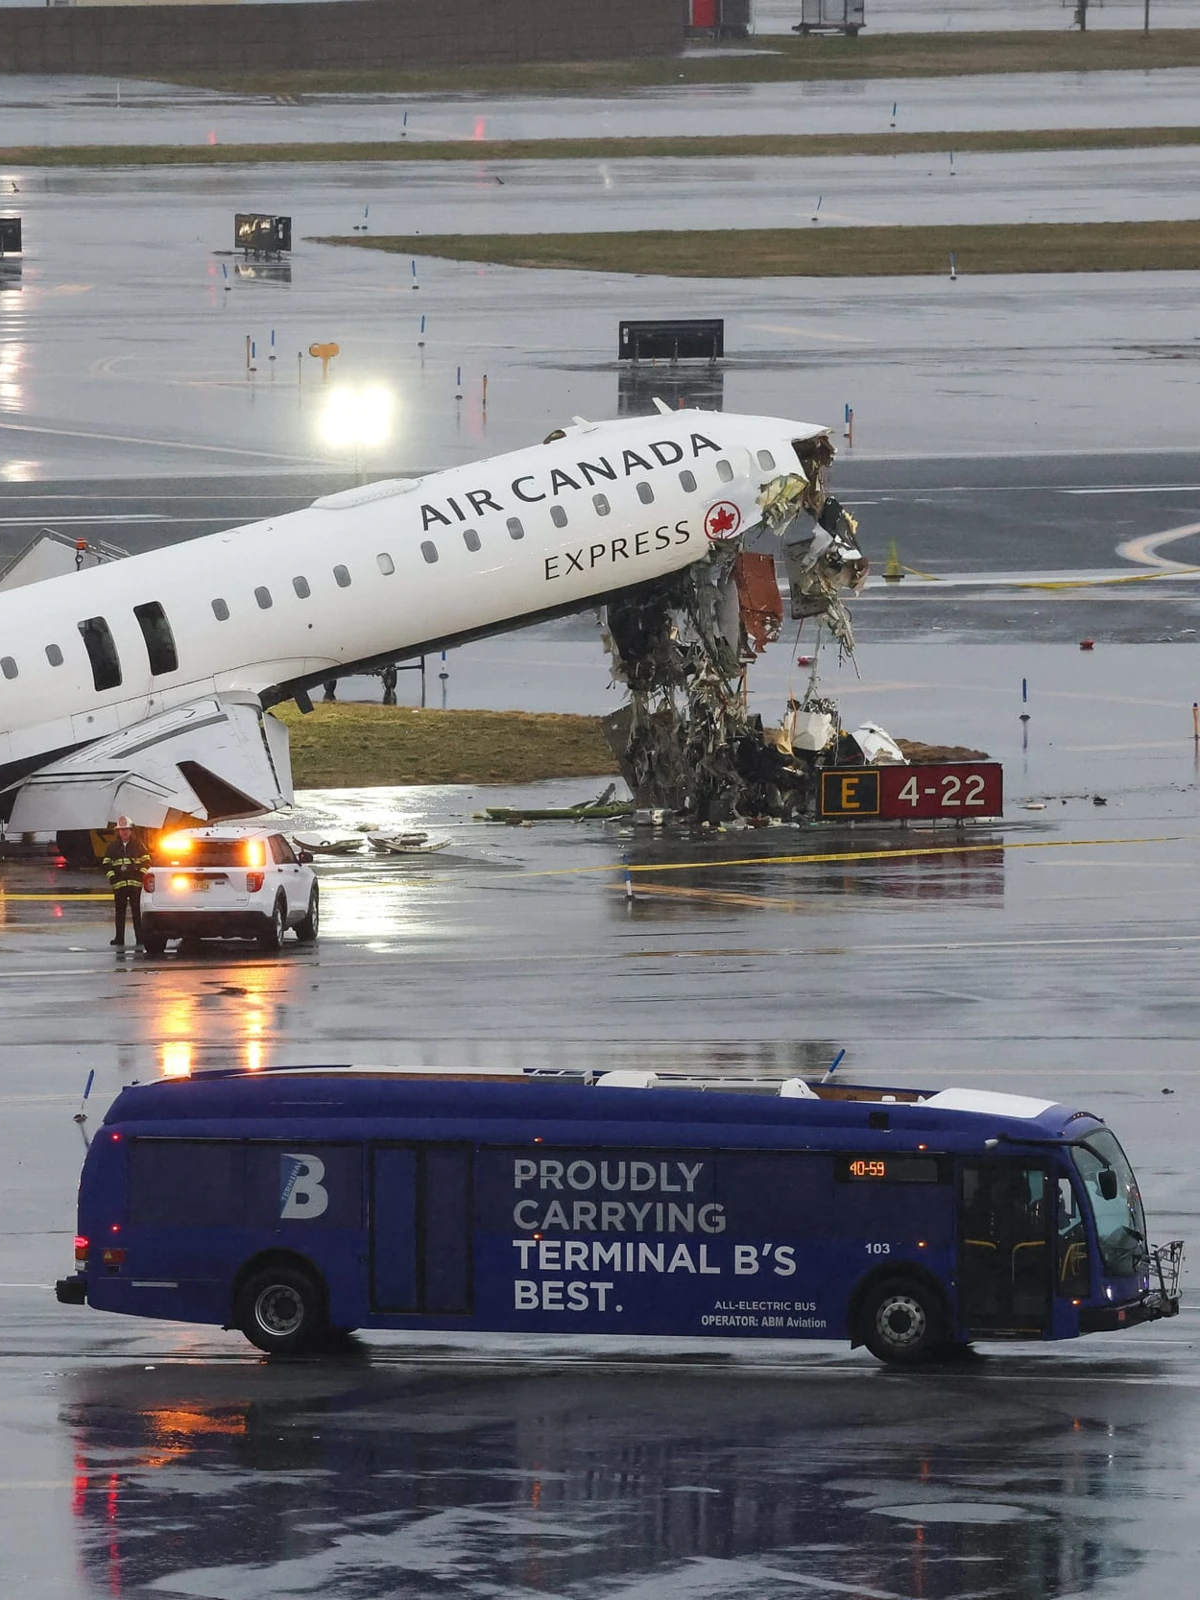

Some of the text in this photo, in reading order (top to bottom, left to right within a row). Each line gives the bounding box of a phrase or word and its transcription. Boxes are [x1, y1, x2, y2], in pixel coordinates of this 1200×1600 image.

[420, 433, 722, 531] AIR CANADA
[544, 520, 690, 580] EXPRESS
[842, 778, 860, 808] E
[898, 774, 986, 807] 4-22
[514, 1159, 704, 1192] PROUDLY
[849, 1161, 885, 1176] 40-59
[280, 1153, 329, 1219] B
[513, 1199, 727, 1234] CARRYING
[512, 1239, 797, 1276] TERMINAL B'S
[865, 1243, 890, 1254] 103
[514, 1279, 624, 1313] BEST.
[714, 1300, 817, 1311] ALL-ELECTRIC BUS
[701, 1315, 827, 1328] OPERATOR: ABM Aviation
